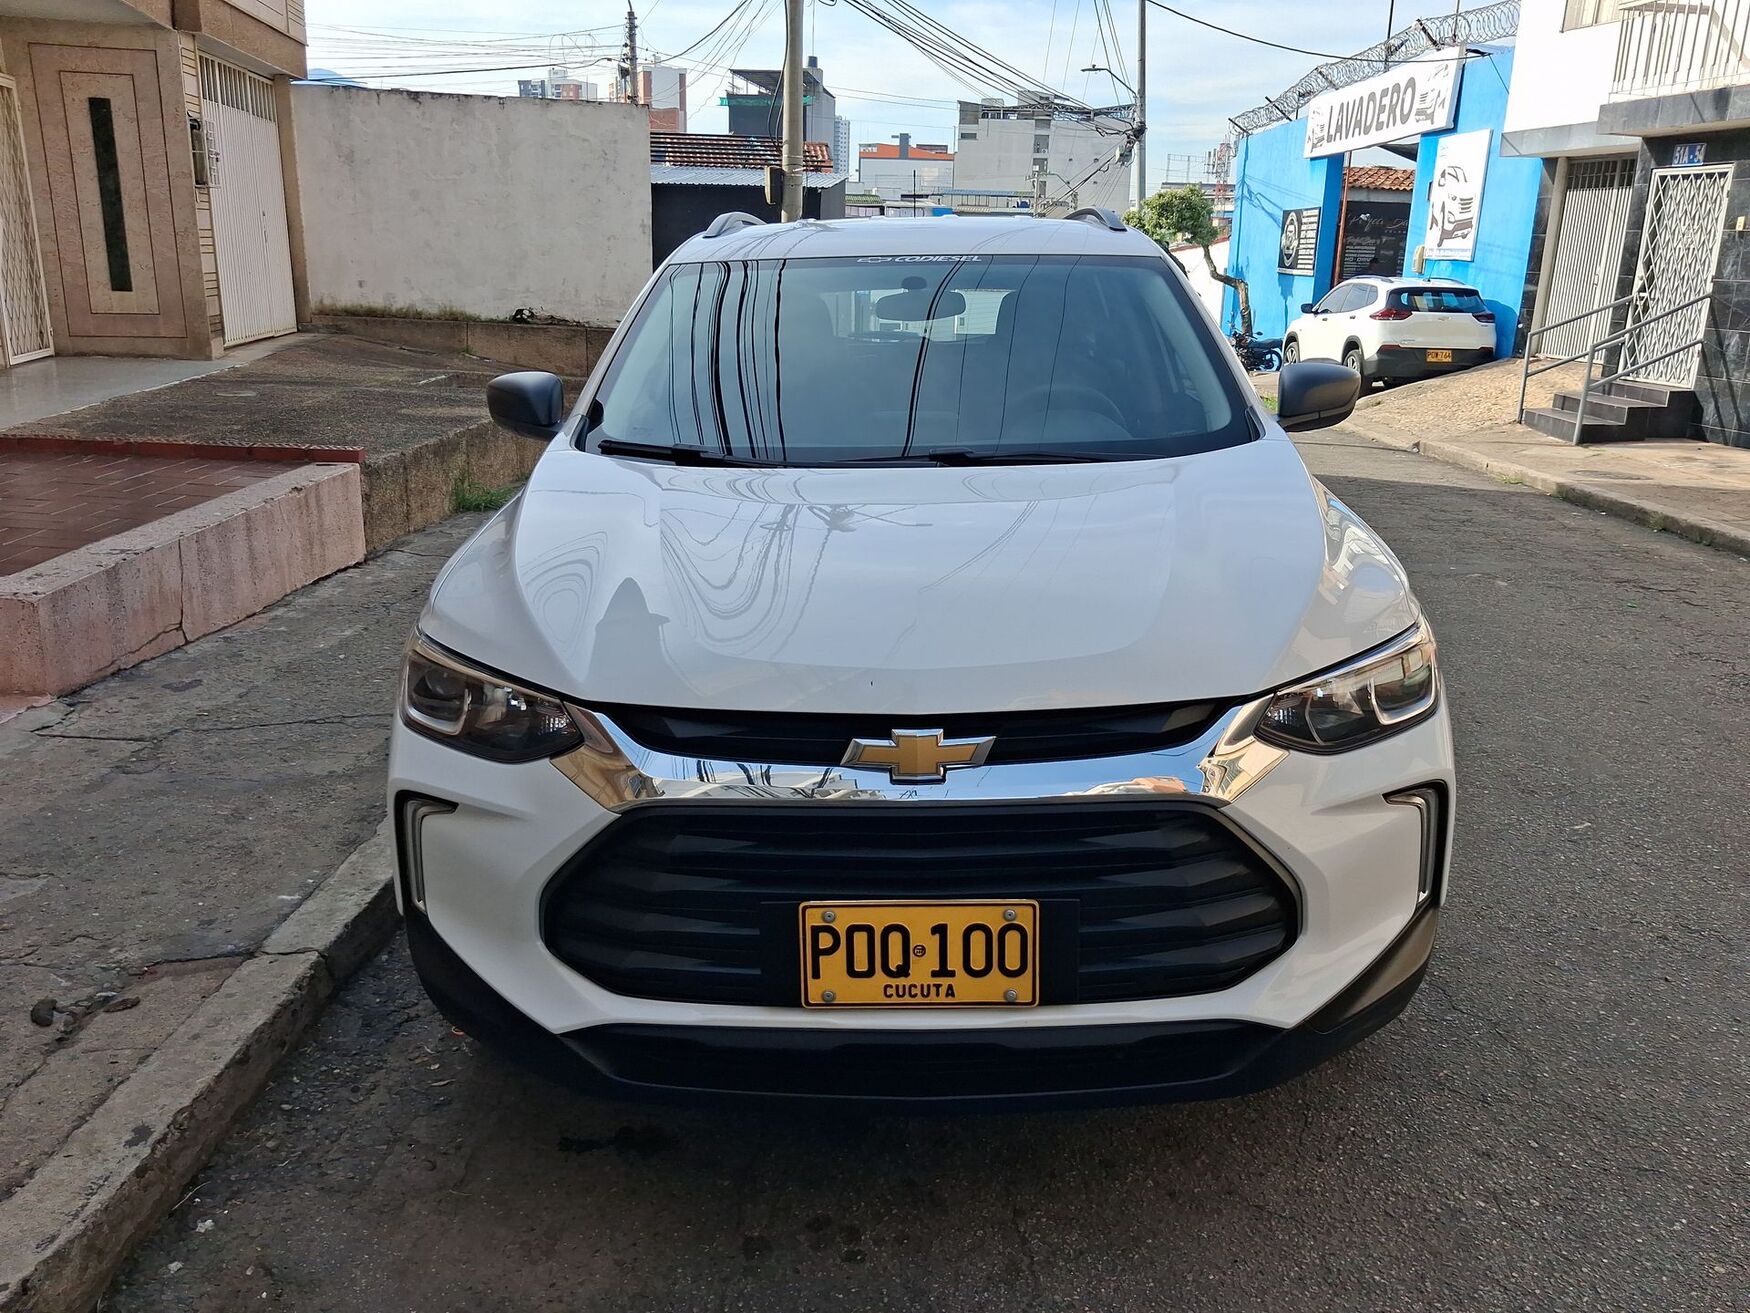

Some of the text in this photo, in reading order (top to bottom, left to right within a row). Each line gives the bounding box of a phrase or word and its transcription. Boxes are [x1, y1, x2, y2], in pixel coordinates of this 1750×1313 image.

[1326, 76, 1417, 144] LAVADERO
[894, 255, 982, 263] CODIESEL
[883, 983, 956, 999] CUCUTA
